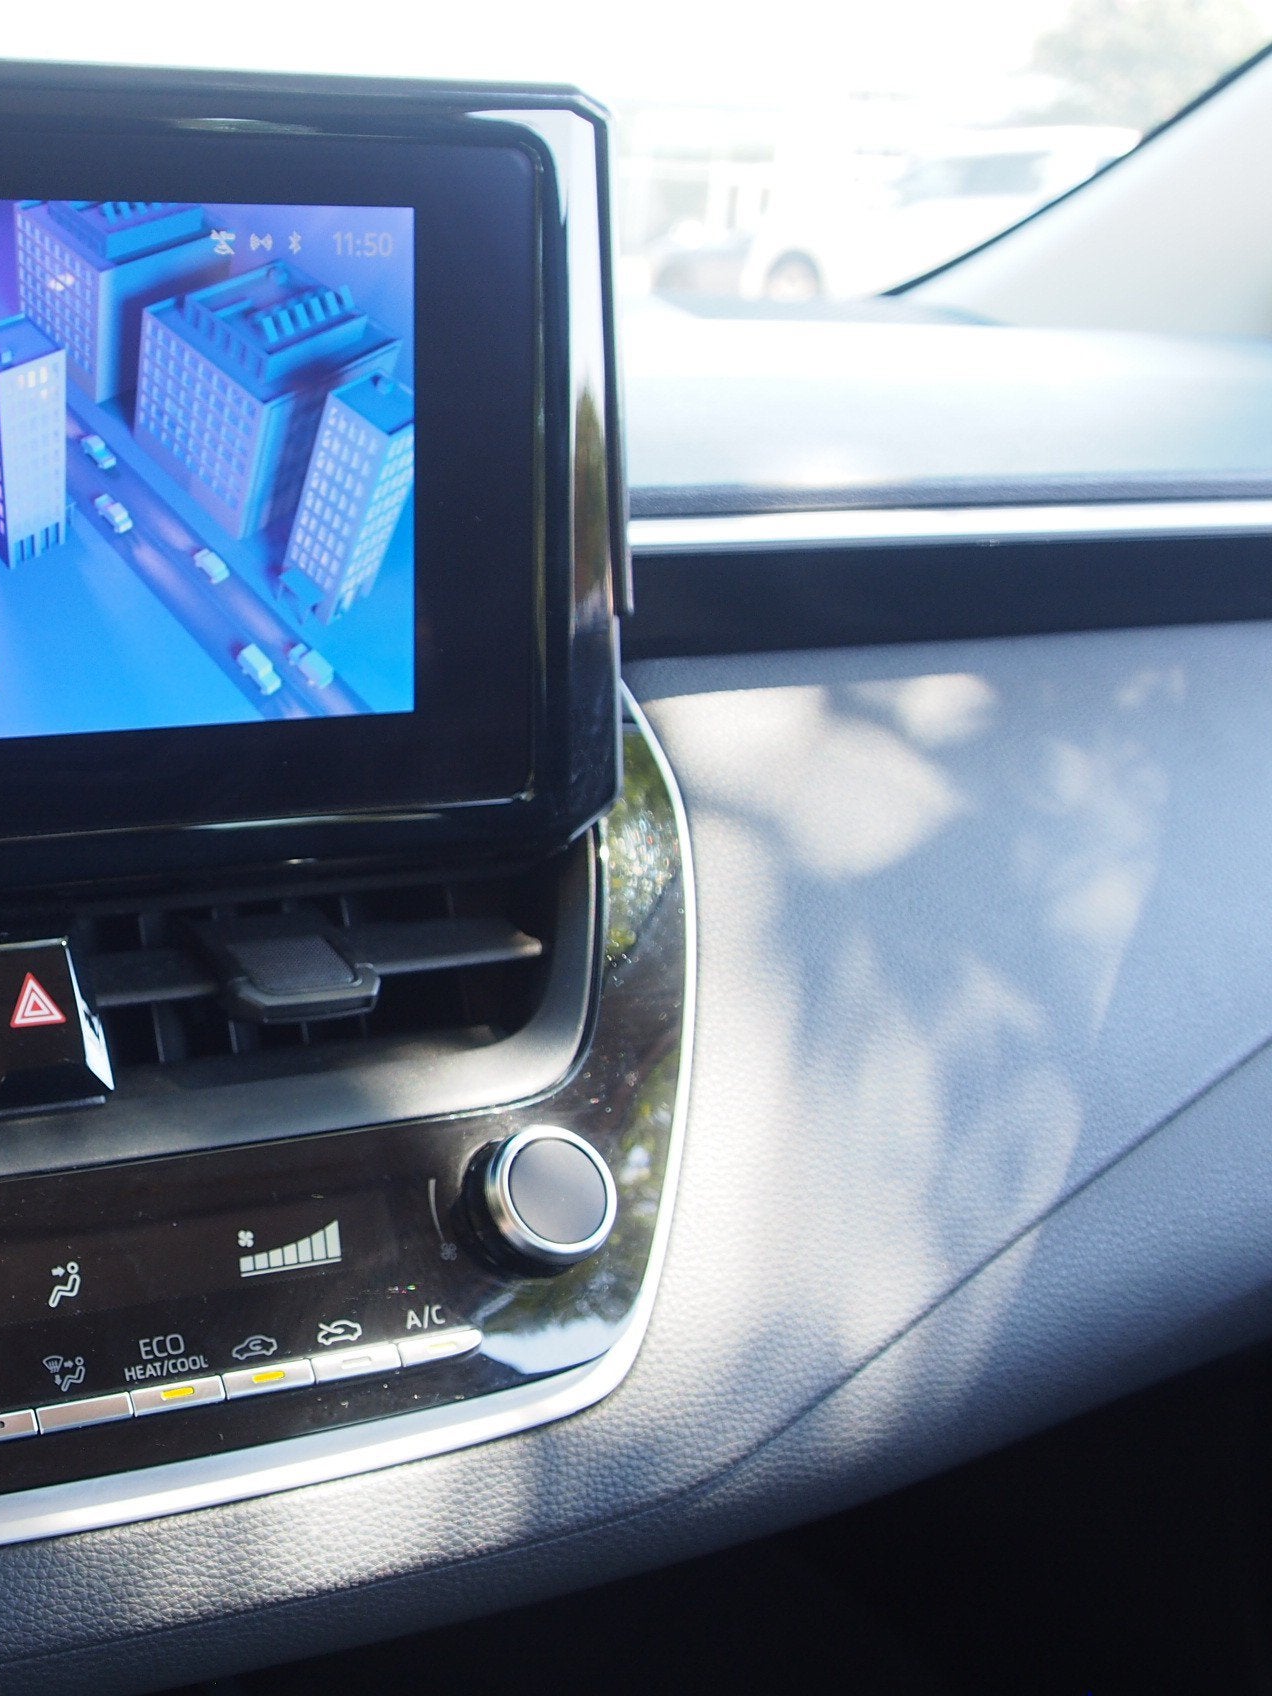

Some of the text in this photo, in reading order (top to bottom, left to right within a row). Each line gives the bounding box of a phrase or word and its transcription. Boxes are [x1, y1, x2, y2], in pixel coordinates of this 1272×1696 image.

[332, 230, 394, 258] 11:50
[405, 1304, 447, 1331] A/C
[139, 1333, 186, 1361] ECO
[124, 1355, 210, 1383] HEAT/COOL
